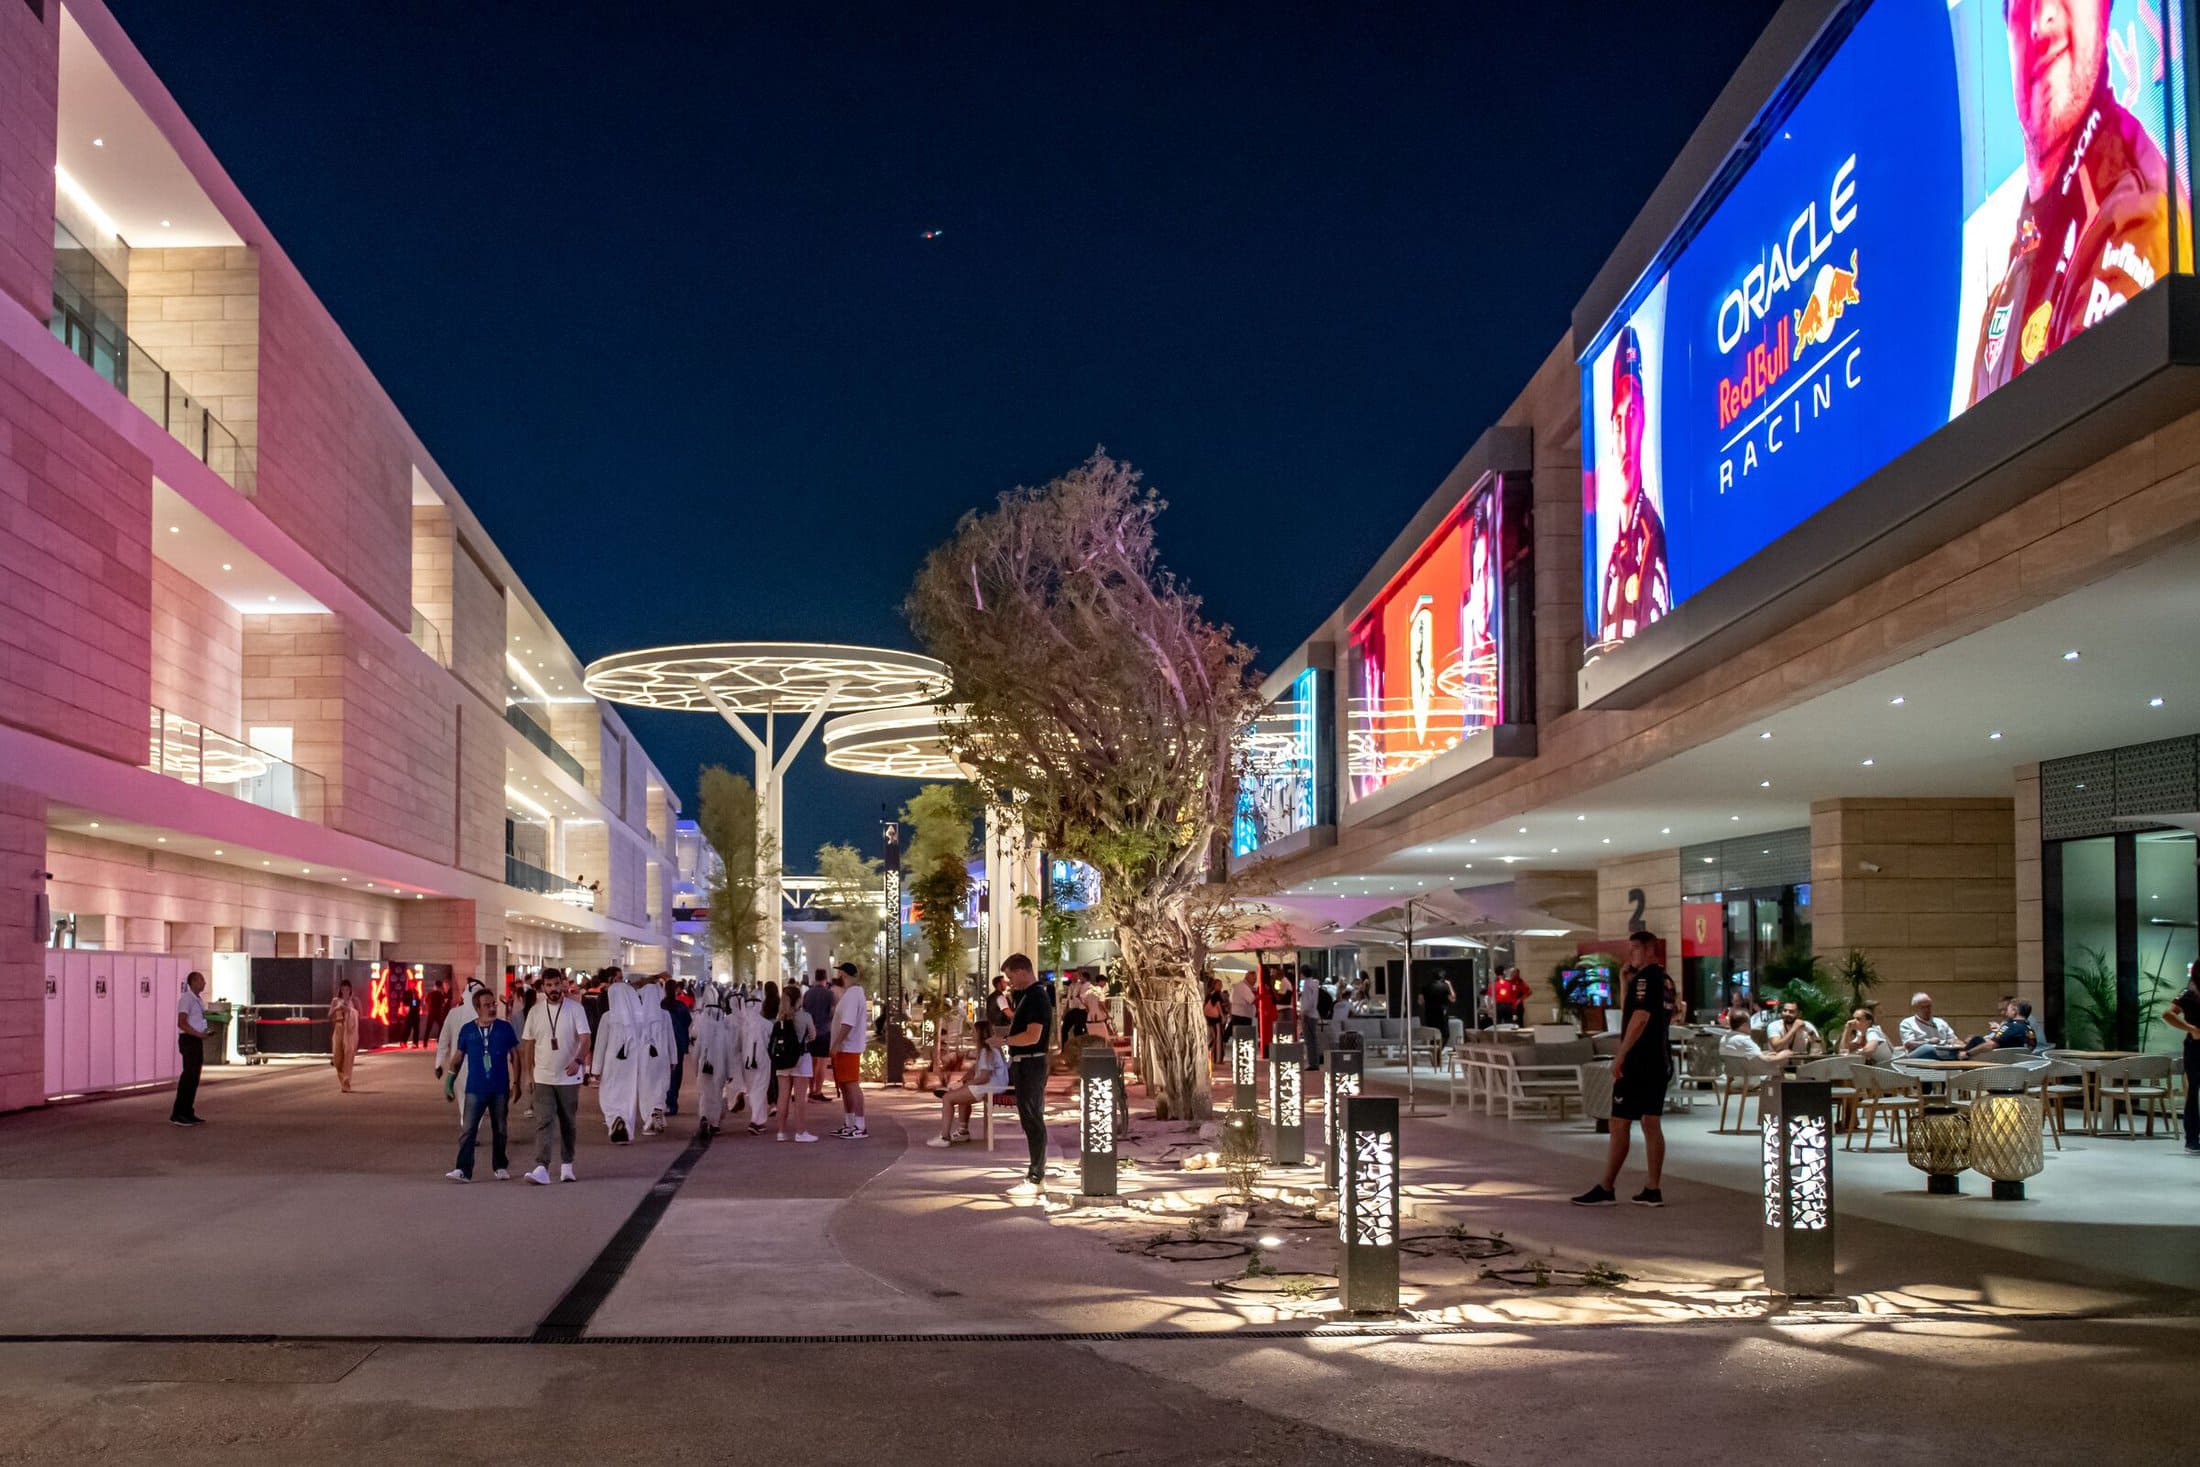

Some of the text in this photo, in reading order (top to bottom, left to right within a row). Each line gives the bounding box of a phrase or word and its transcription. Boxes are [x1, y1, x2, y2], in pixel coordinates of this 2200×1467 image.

[1717, 153, 1858, 354] ORACLE
[1718, 314, 1790, 430] Red Bull
[1628, 888, 1647, 932] 2
